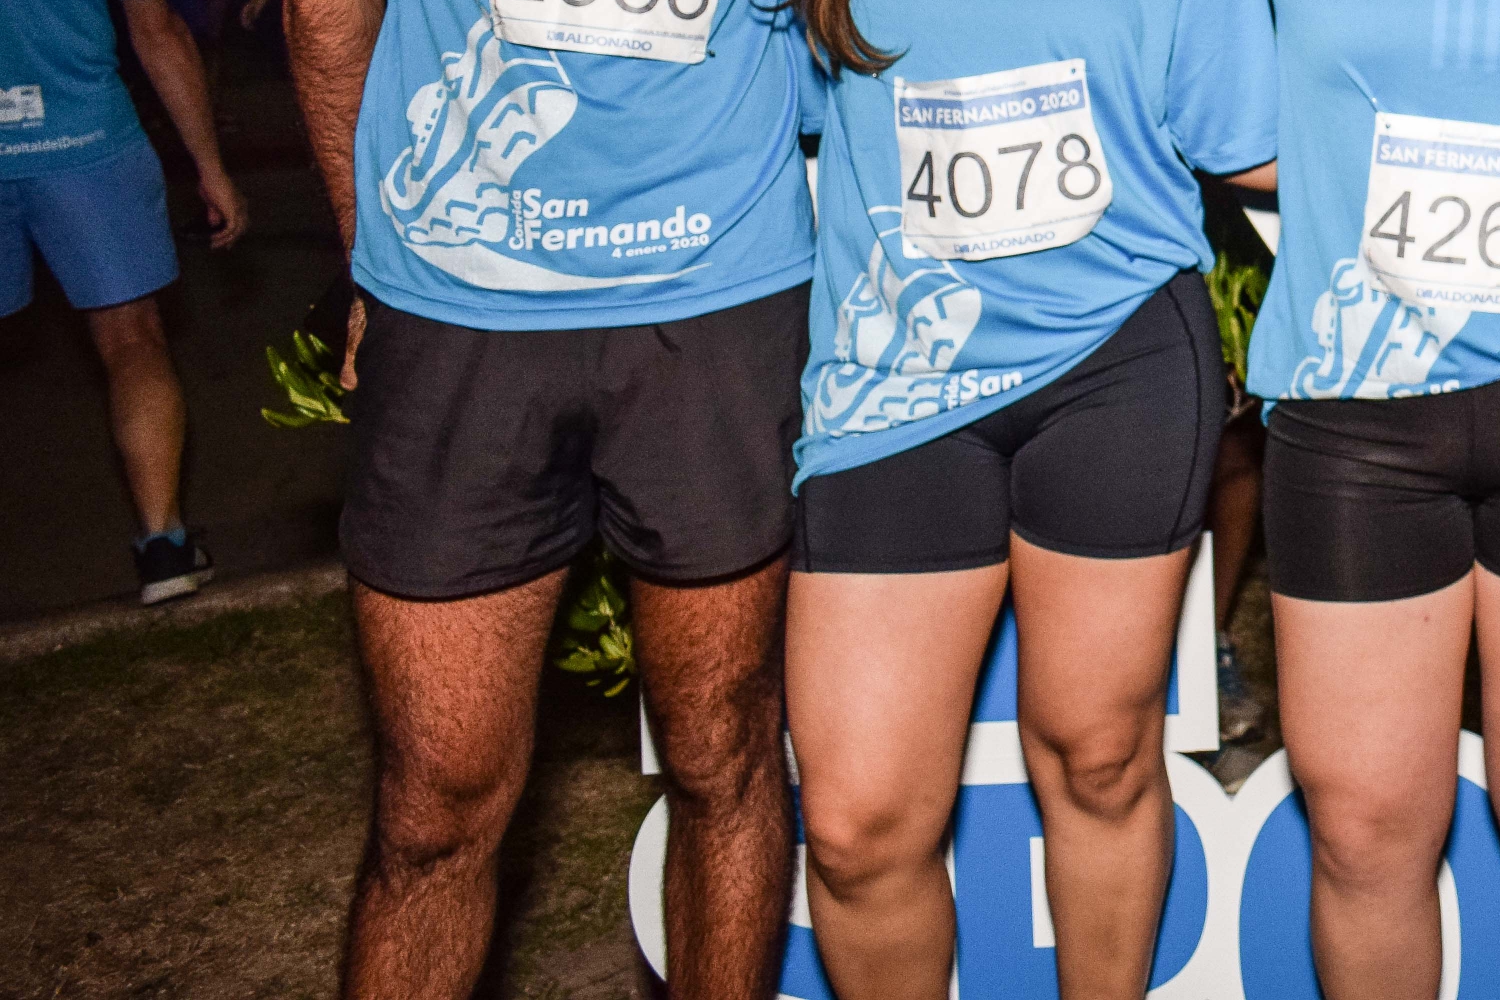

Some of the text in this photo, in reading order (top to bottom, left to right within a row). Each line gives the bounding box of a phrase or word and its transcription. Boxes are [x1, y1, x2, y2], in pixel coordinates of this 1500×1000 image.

[902, 89, 1080, 125] SAN FERNANDO 2020
[1379, 143, 1419, 164] SAN
[907, 133, 1102, 219] 4078
[523, 188, 589, 220] San
[524, 205, 712, 251] Fernando
[612, 233, 710, 259] 4 enero 2020
[960, 369, 1023, 401] San
